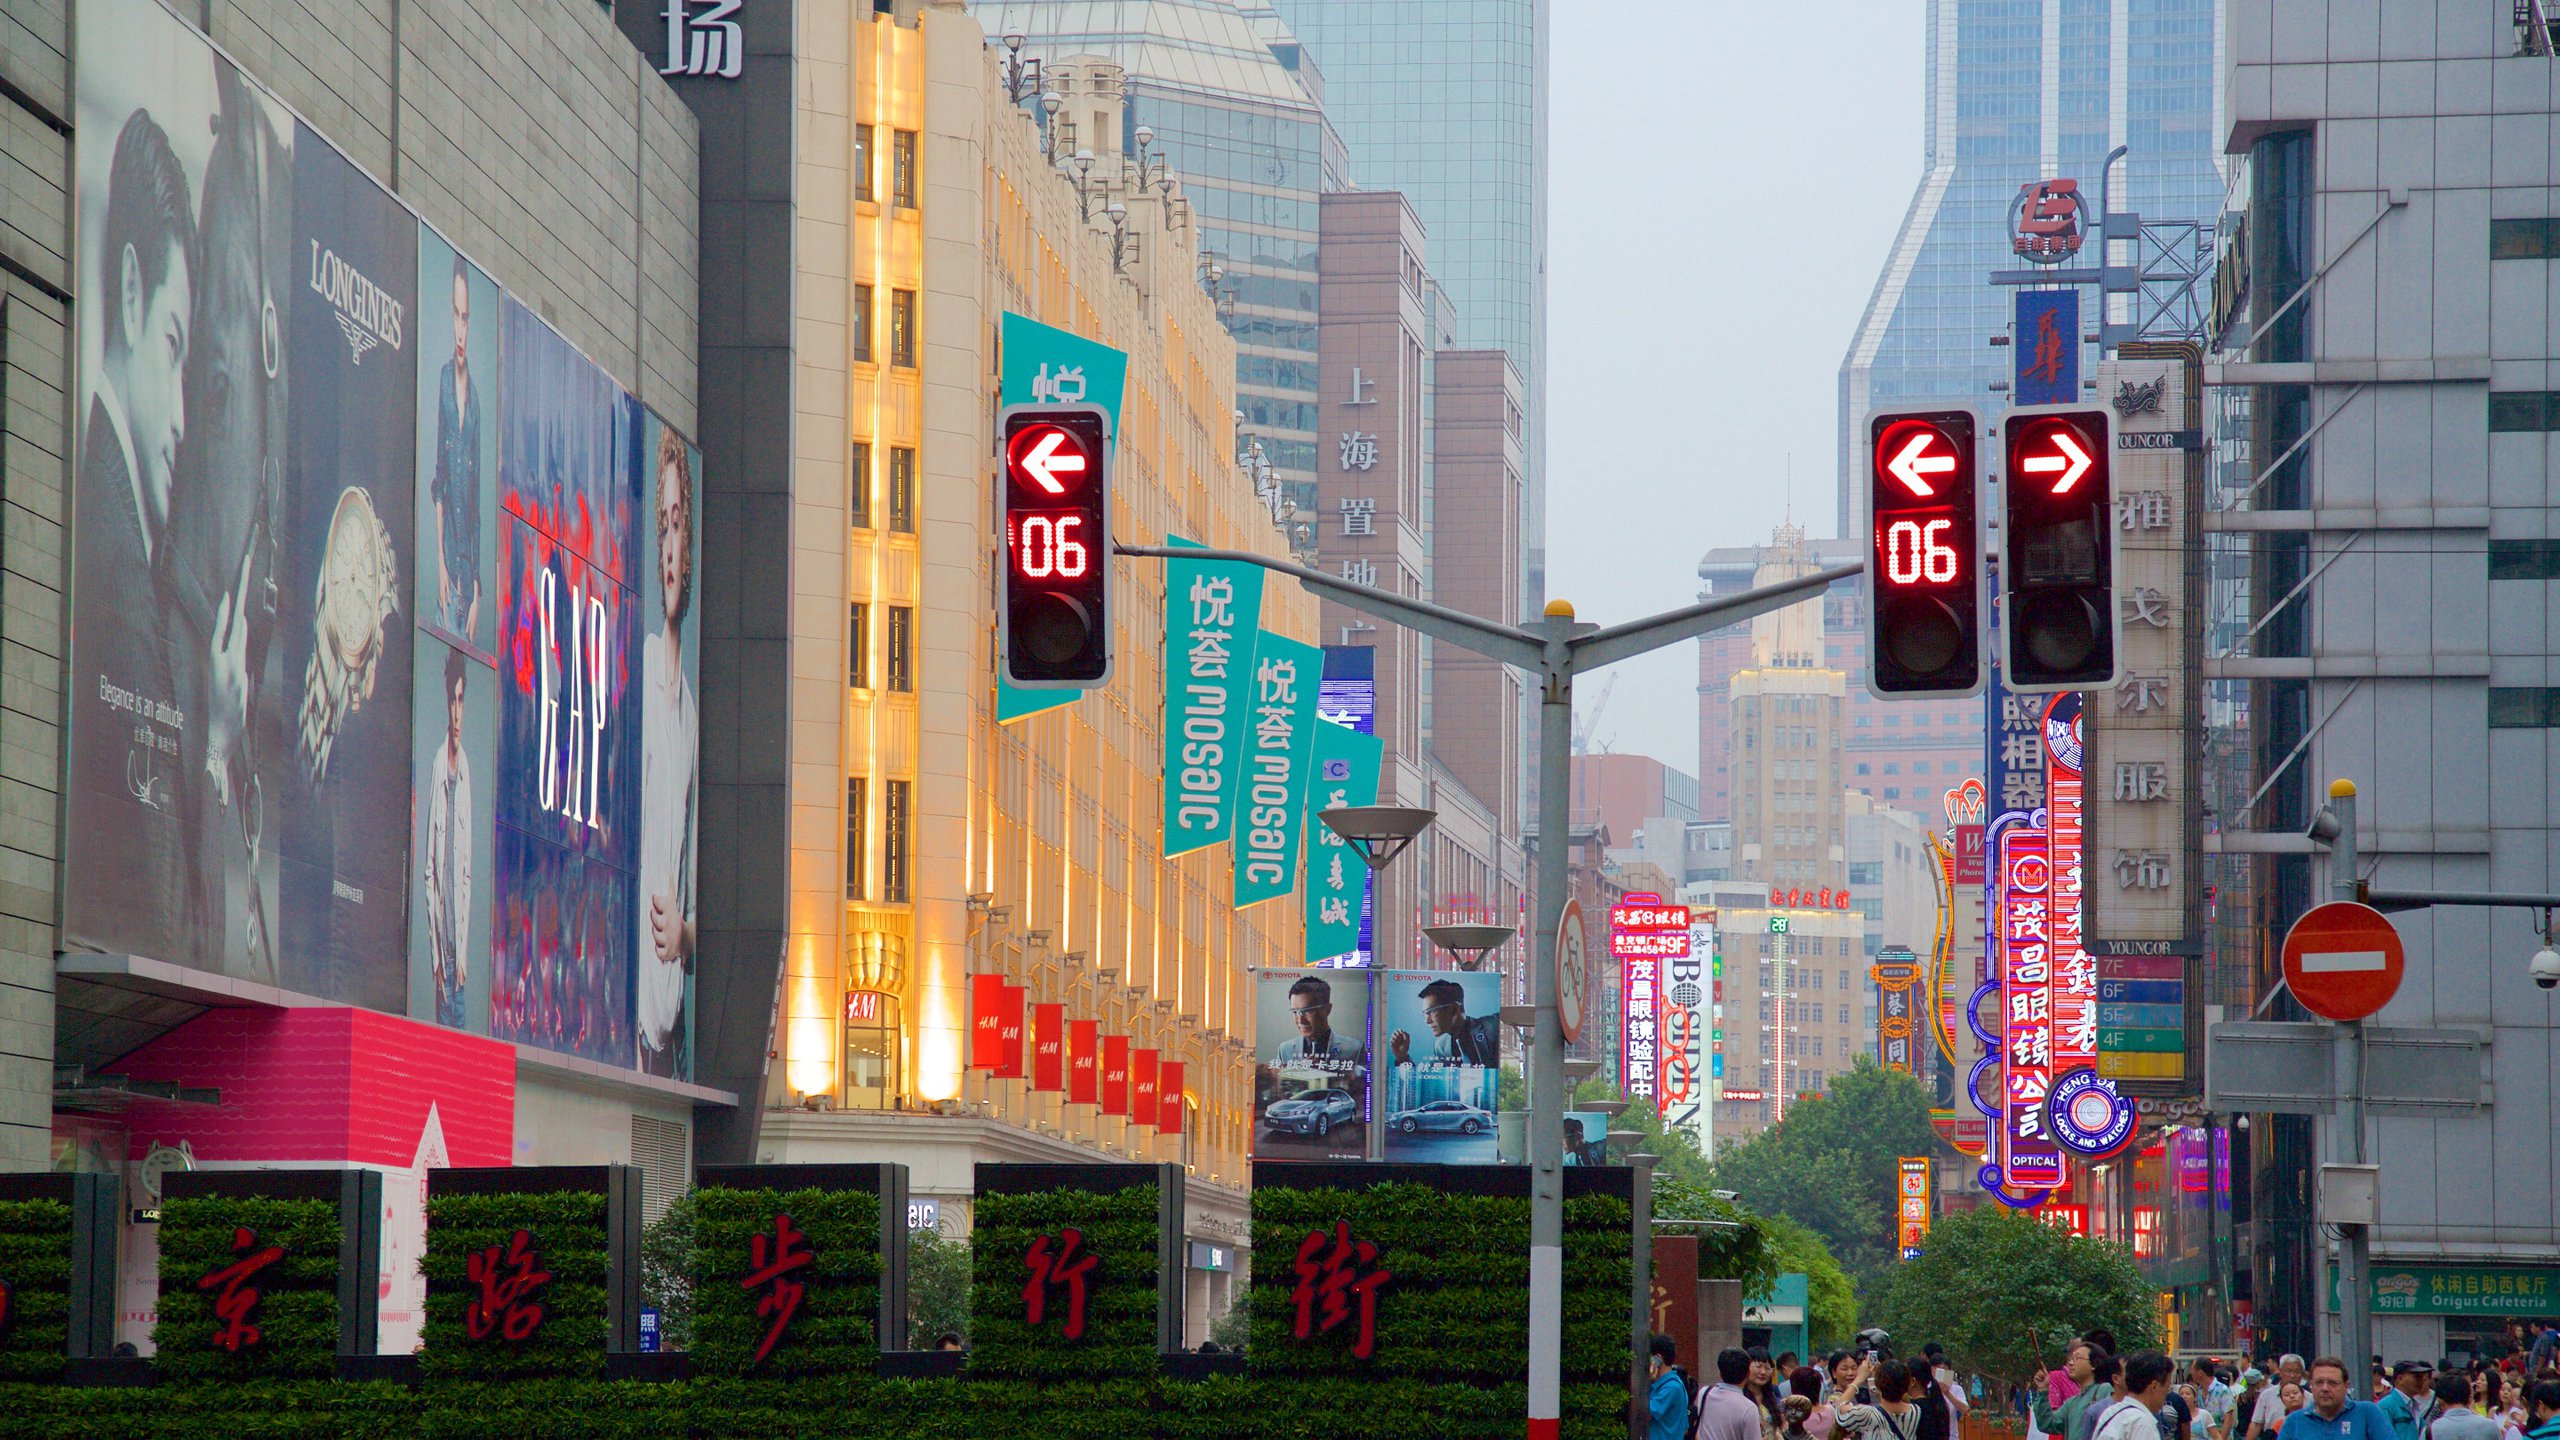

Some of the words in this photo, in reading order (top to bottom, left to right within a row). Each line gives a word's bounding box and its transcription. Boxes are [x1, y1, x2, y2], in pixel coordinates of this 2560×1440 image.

[659, 0, 743, 78] 场
[310, 238, 402, 350] LONGINES
[2116, 434, 2174, 449] OUNGOR
[1021, 514, 1087, 579] 06
[1888, 518, 1957, 584] 06
[2111, 490, 2172, 890] 雅戈尔服饰
[100, 674, 134, 710] Elegance
[135, 688, 142, 714] is
[143, 698, 154, 719] an
[155, 700, 184, 730] attitude
[537, 567, 608, 830] GAP
[1667, 936, 1687, 954] 9F
[2103, 959, 2125, 974] 7F
[1405, 974, 1432, 982] TOYOTA
[2103, 983, 2125, 998] 6F
[979, 1016, 998, 1029] H&M
[2103, 1008, 2125, 1022] 5F
[2103, 1032, 2125, 1046] 4F
[1040, 1042, 1058, 1054] H&M
[1075, 1057, 1092, 1068] H&M
[2103, 1057, 2125, 1072] 3F
[1107, 1071, 1124, 1082] H&M
[1137, 1082, 1153, 1093] H&M
[2056, 1074, 2091, 1102] HENG
[1164, 1094, 1179, 1104] H&M
[2055, 1112, 2076, 1141] LOCKS
[2077, 1137, 2097, 1149] AND
[2099, 1109, 2129, 1146] WATCHES
[2012, 1156, 2057, 1168] OPTICAL
[2431, 1275, 2548, 1295] 休闲自助西餐厅
[2431, 1295, 2478, 1309] Origus
[2482, 1295, 2548, 1308] Cafeteria
